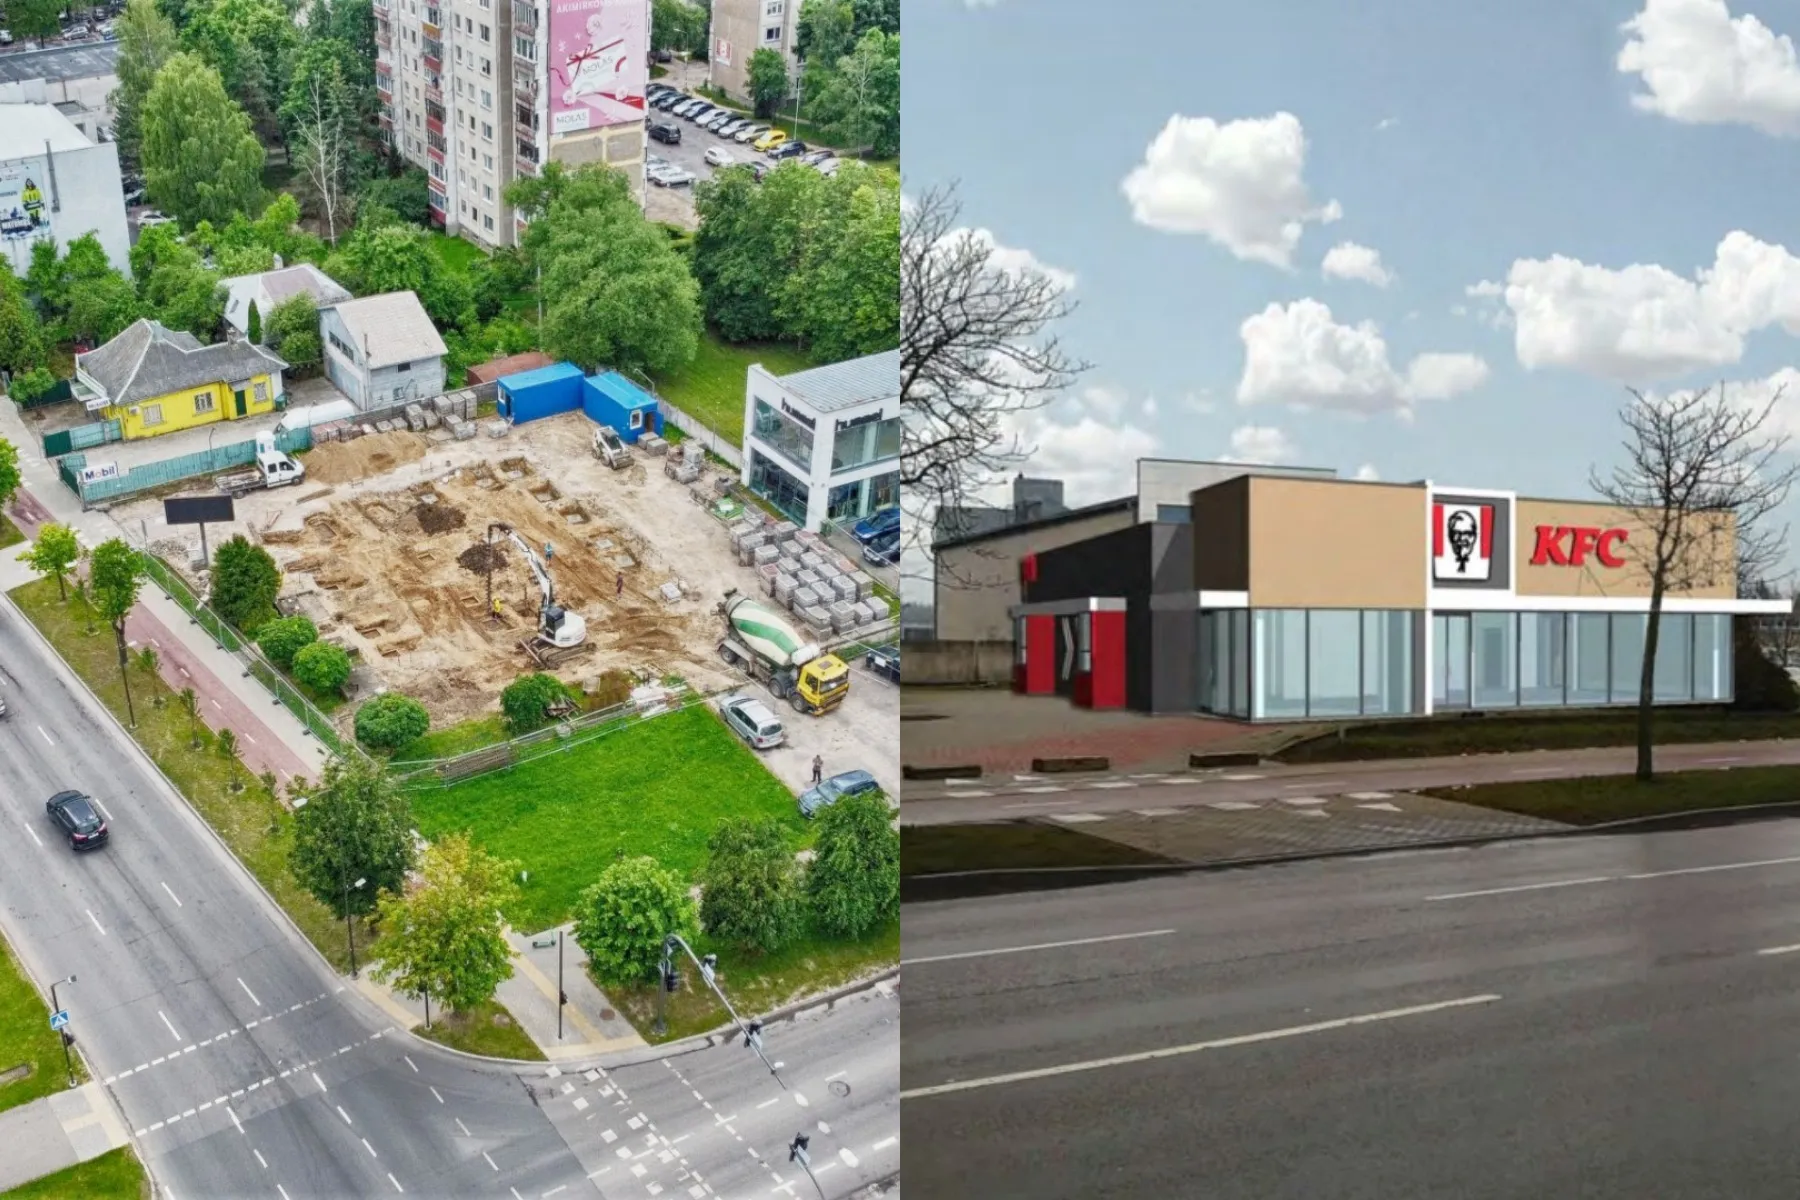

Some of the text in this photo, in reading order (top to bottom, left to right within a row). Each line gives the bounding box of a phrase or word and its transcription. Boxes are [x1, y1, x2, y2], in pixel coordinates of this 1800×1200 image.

[556, 111, 587, 124] MOLAS
[85, 466, 115, 480] Mobil
[1529, 526, 1628, 568] KFC
